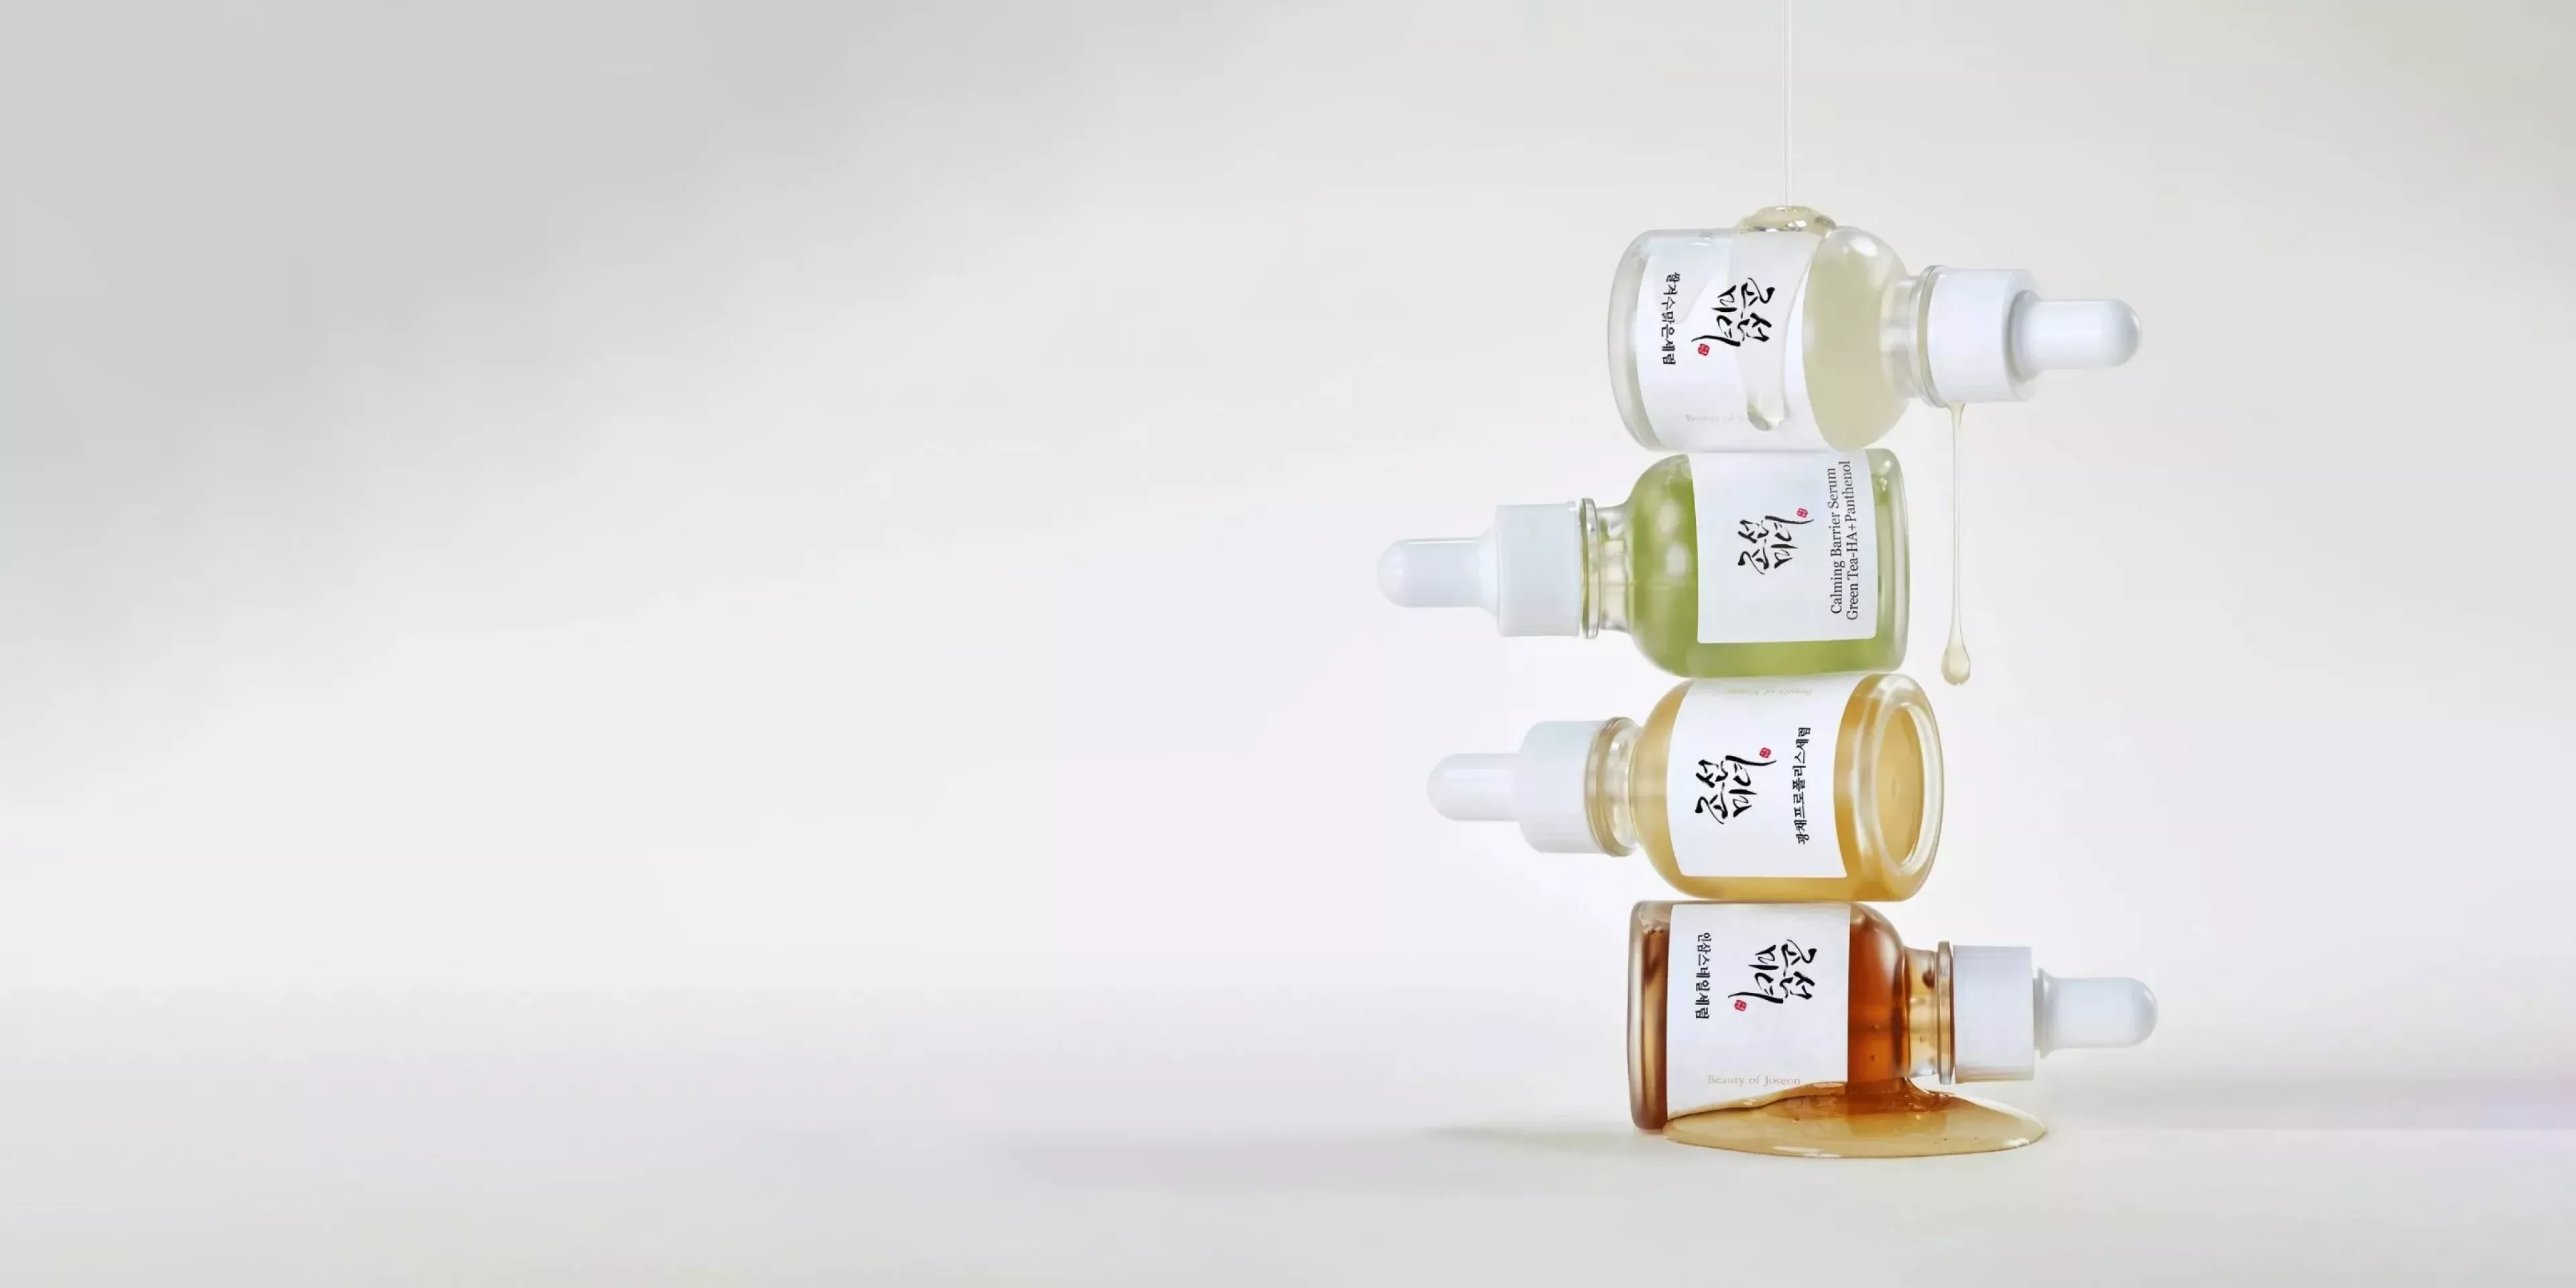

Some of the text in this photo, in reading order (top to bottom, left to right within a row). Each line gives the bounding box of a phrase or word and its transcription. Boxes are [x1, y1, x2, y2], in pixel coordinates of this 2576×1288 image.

[1661, 272, 1680, 365] 쌀겨수맑은세럼
[1827, 468, 1845, 614] Calming Barrier Serum
[1838, 460, 1859, 621] Green Tea-HA+Panthenol
[1792, 727, 1811, 845] 광채프로폴리스세럼
[1695, 932, 1712, 1020] 인삼스네일세럼
[1708, 1075, 1801, 1087] Beauty of Joseon
